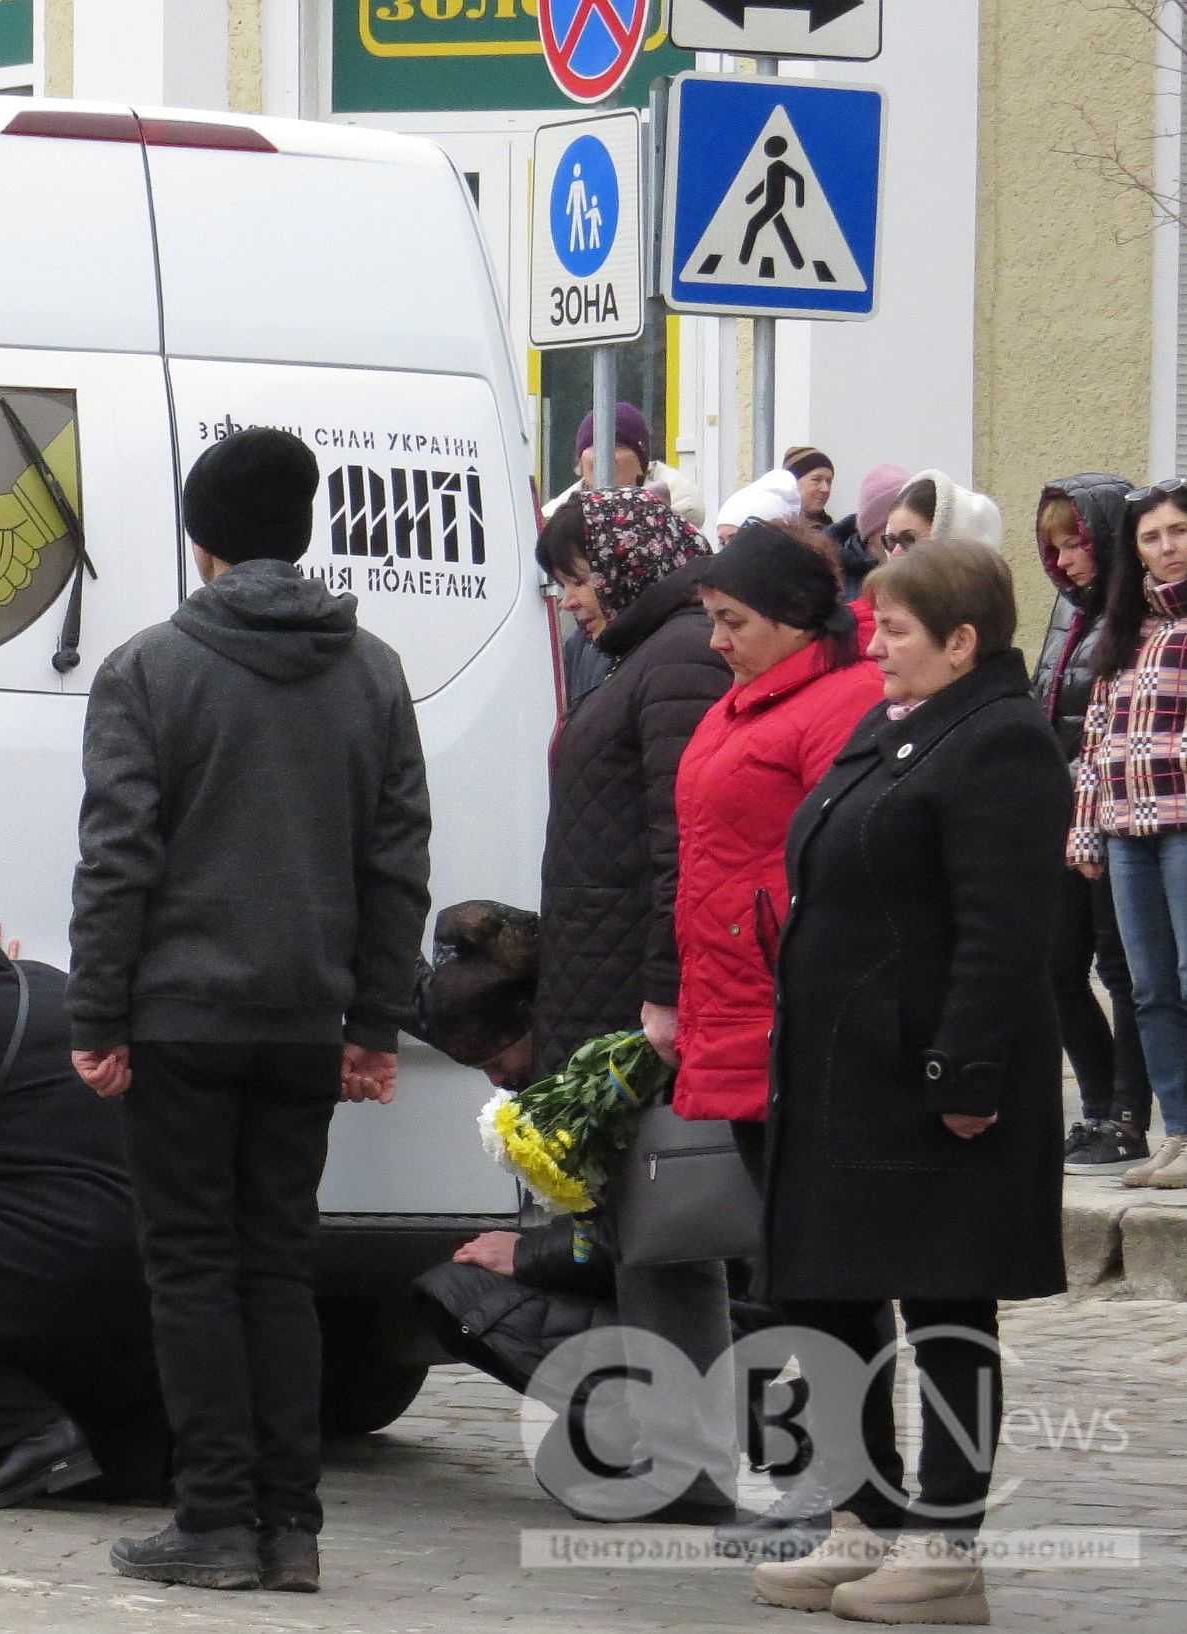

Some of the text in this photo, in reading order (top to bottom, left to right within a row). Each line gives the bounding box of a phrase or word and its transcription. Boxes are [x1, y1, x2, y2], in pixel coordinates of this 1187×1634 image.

[550, 283, 619, 326] ЗОНА
[314, 428, 375, 450] СИЛИ
[387, 433, 479, 458] УКРАЇНИ
